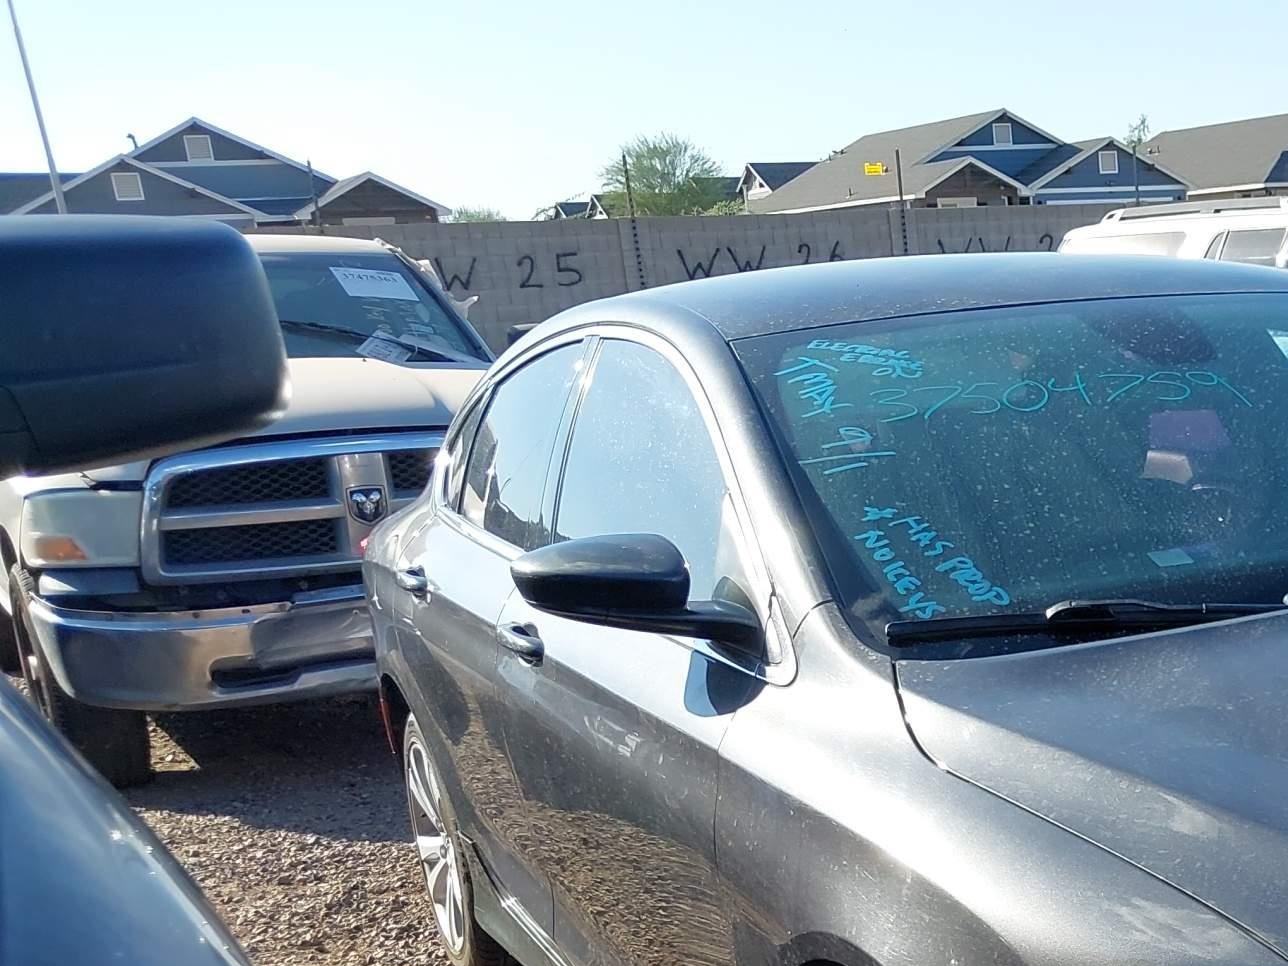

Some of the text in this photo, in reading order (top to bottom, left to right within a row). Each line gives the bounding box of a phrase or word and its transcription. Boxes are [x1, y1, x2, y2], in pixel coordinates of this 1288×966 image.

[516, 252, 583, 289] 25
[677, 245, 767, 280] WW
[869, 371, 1253, 423] 37504759
[887, 516, 955, 556] HAS
